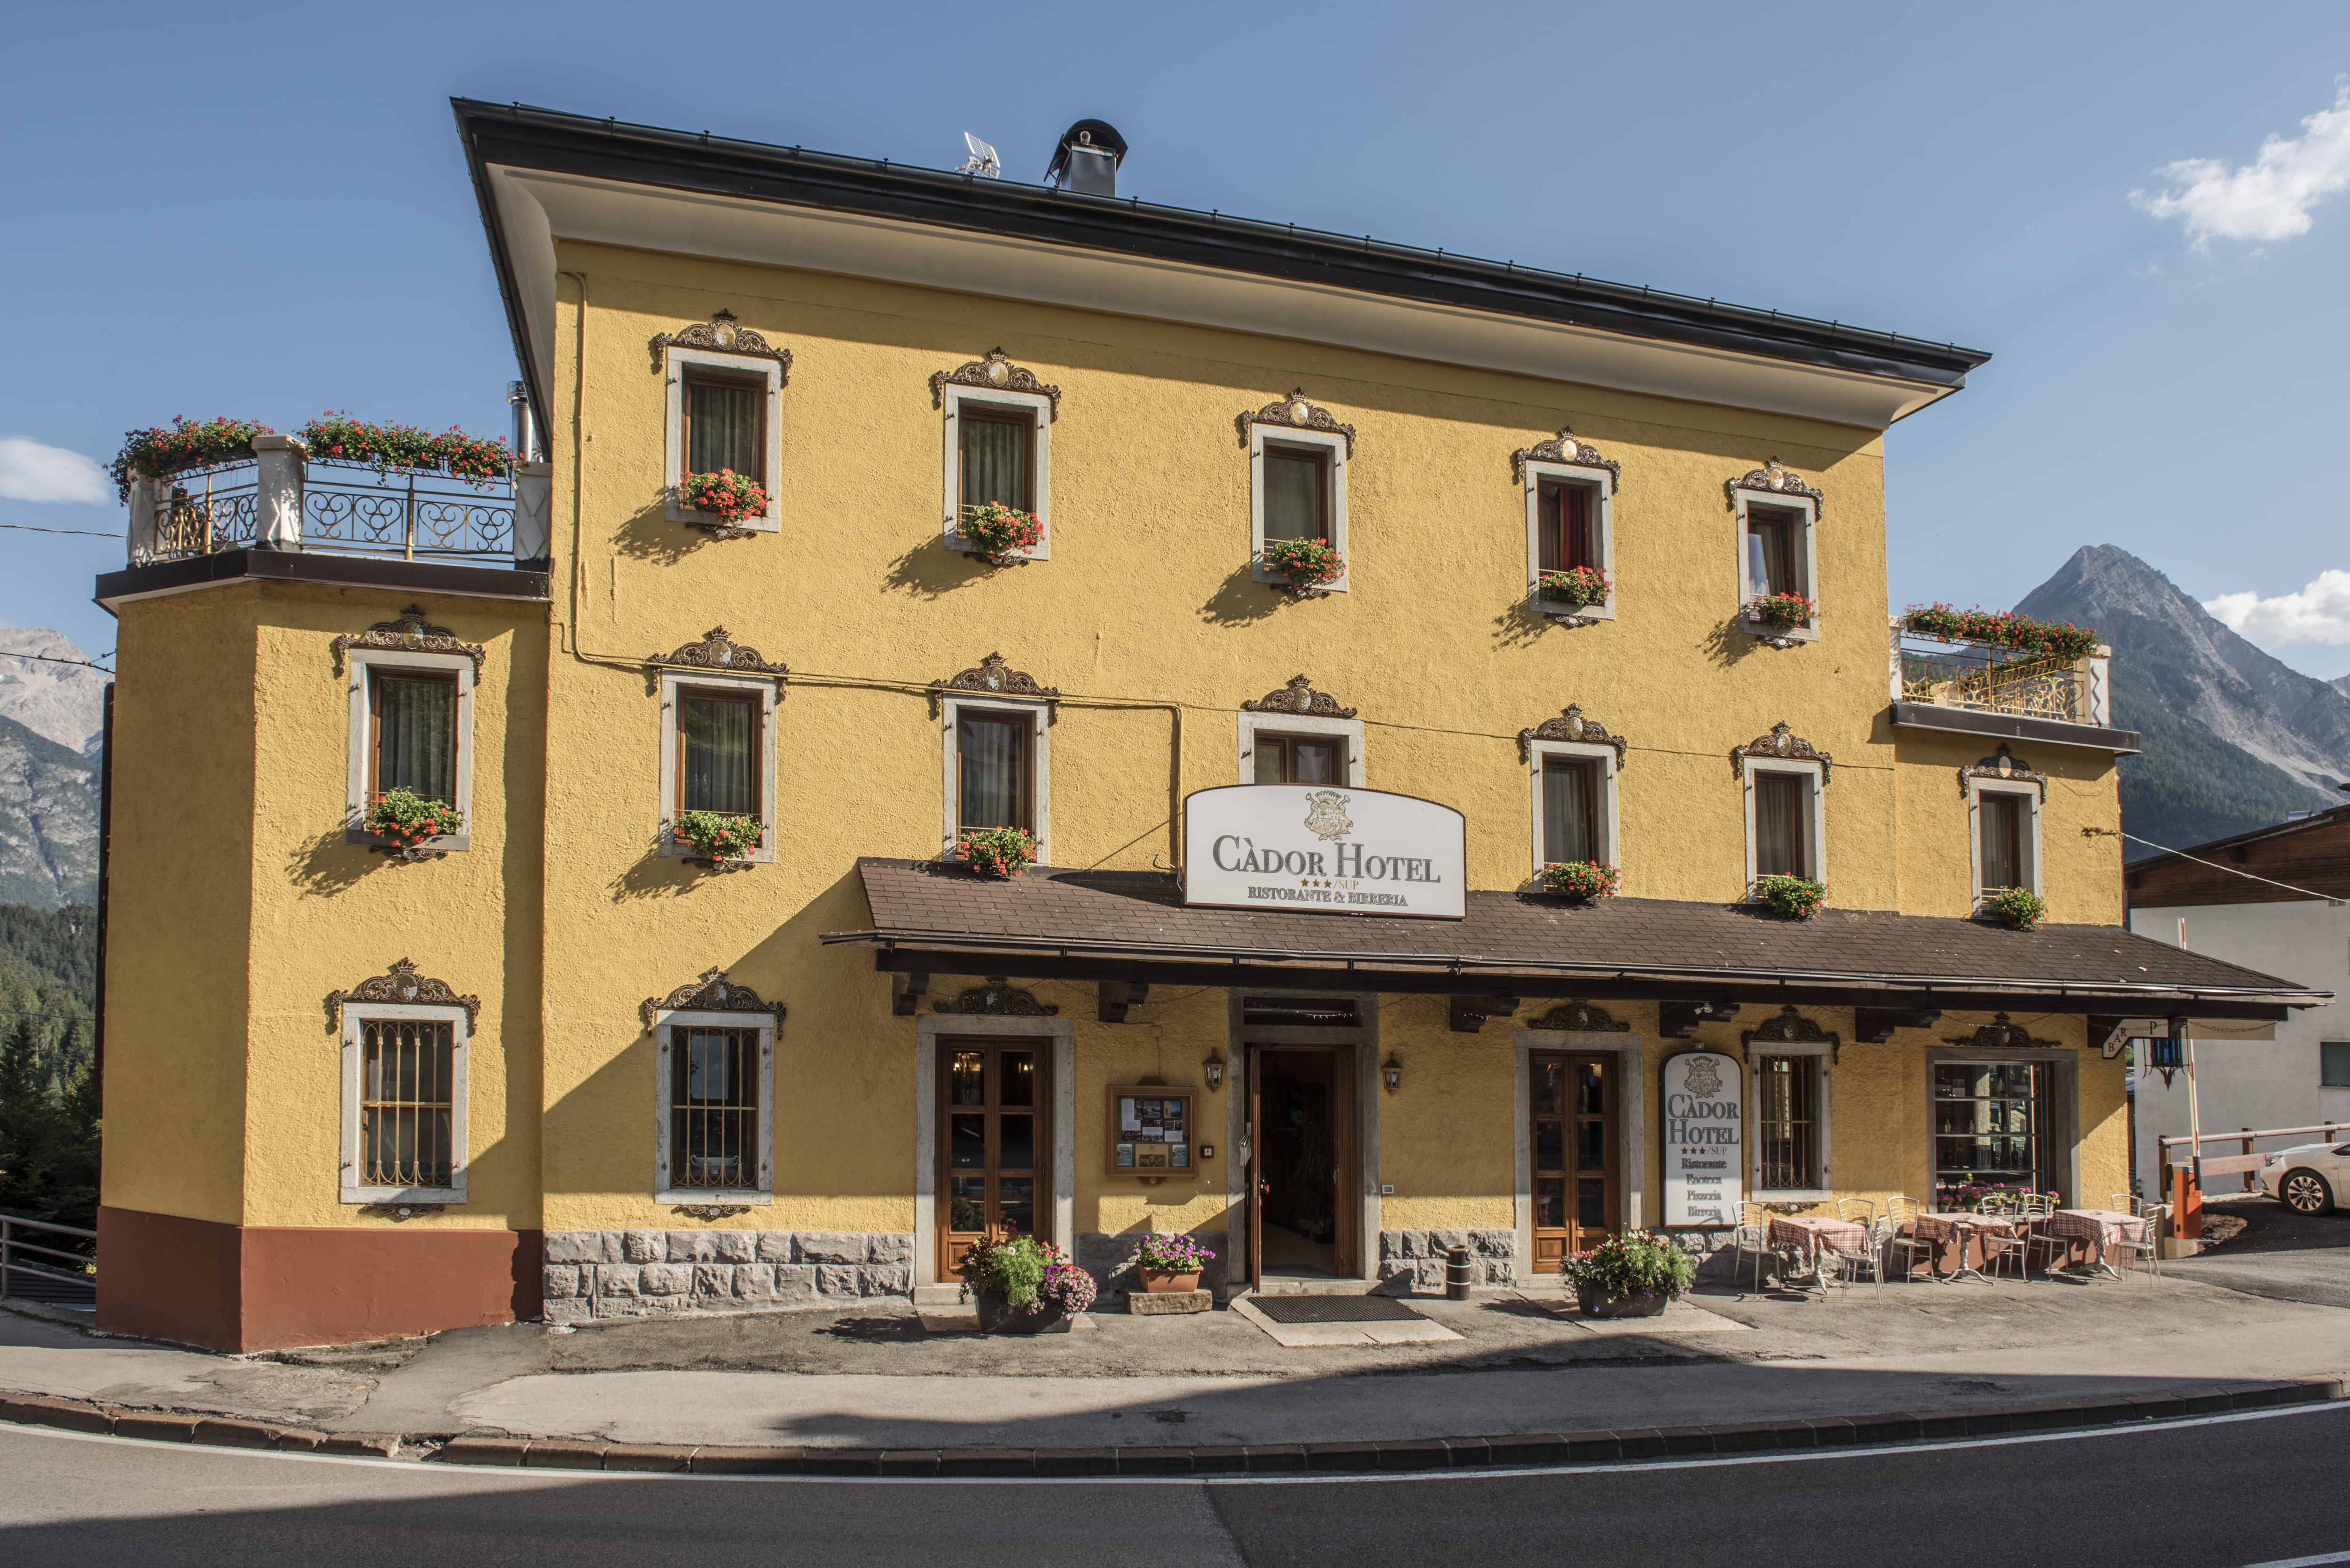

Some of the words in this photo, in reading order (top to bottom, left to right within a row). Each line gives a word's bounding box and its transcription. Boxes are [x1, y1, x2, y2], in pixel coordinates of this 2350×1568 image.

[1213, 835, 1327, 877] CÀDOR
[1333, 843, 1441, 883] HOTEL
[1248, 887, 1331, 903] RISTORANTE
[1334, 891, 1345, 904] &
[1347, 892, 1409, 906] BIRRERIA
[2148, 1021, 2157, 1035] P
[2108, 1027, 2127, 1052] BAR
[1668, 1093, 1739, 1119] CÀDOR
[1668, 1119, 1739, 1144] HOTEL
[1681, 1158, 1727, 1169] Ristorante
[1686, 1174, 1722, 1185] Enoteca
[1686, 1190, 1722, 1201] Pizzeria
[1687, 1206, 1722, 1217] Birreria
